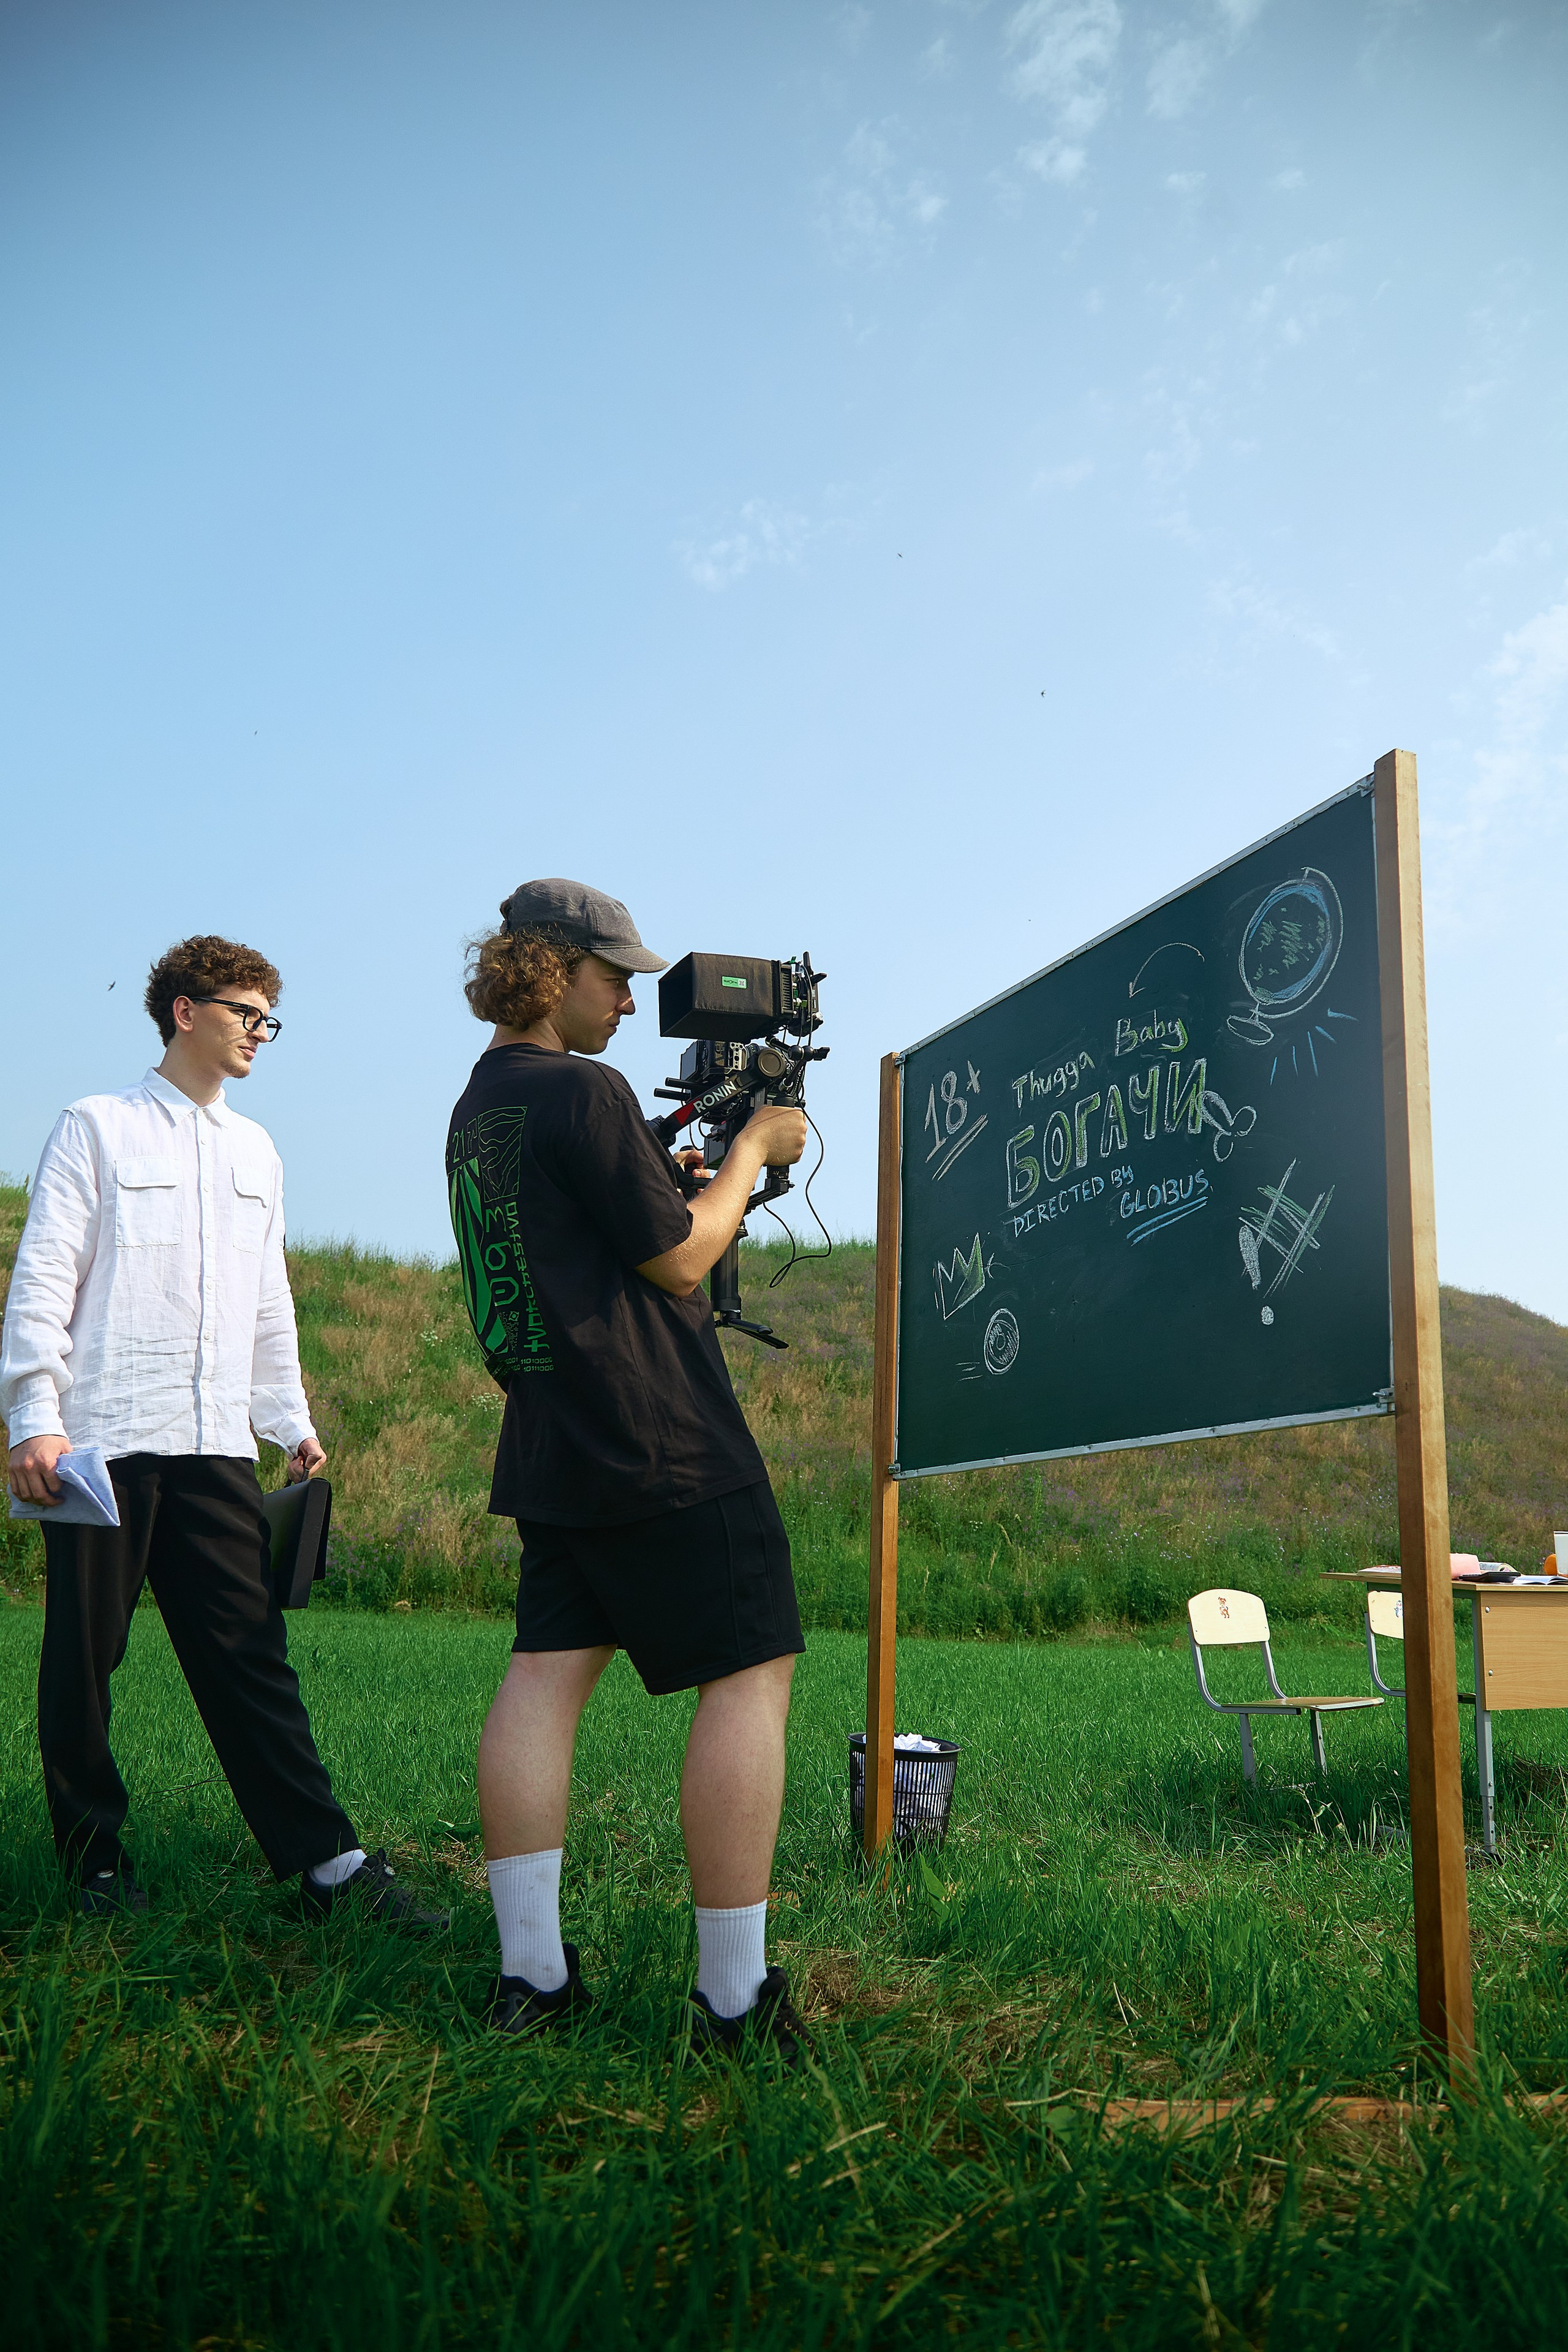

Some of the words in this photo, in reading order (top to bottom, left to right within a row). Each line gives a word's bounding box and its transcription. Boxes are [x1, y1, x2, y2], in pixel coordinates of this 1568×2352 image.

[693, 1080, 737, 1114] RONIN
[1011, 1051, 1096, 1109] Thugga
[1115, 1009, 1188, 1057] Baby
[924, 1060, 981, 1163] 18+
[1006, 1058, 1207, 1208] БОГАЧИ
[1013, 1176, 1104, 1238] DIRECTED
[1110, 1164, 1134, 1188] BY
[1120, 1168, 1210, 1219] GLOBUS
